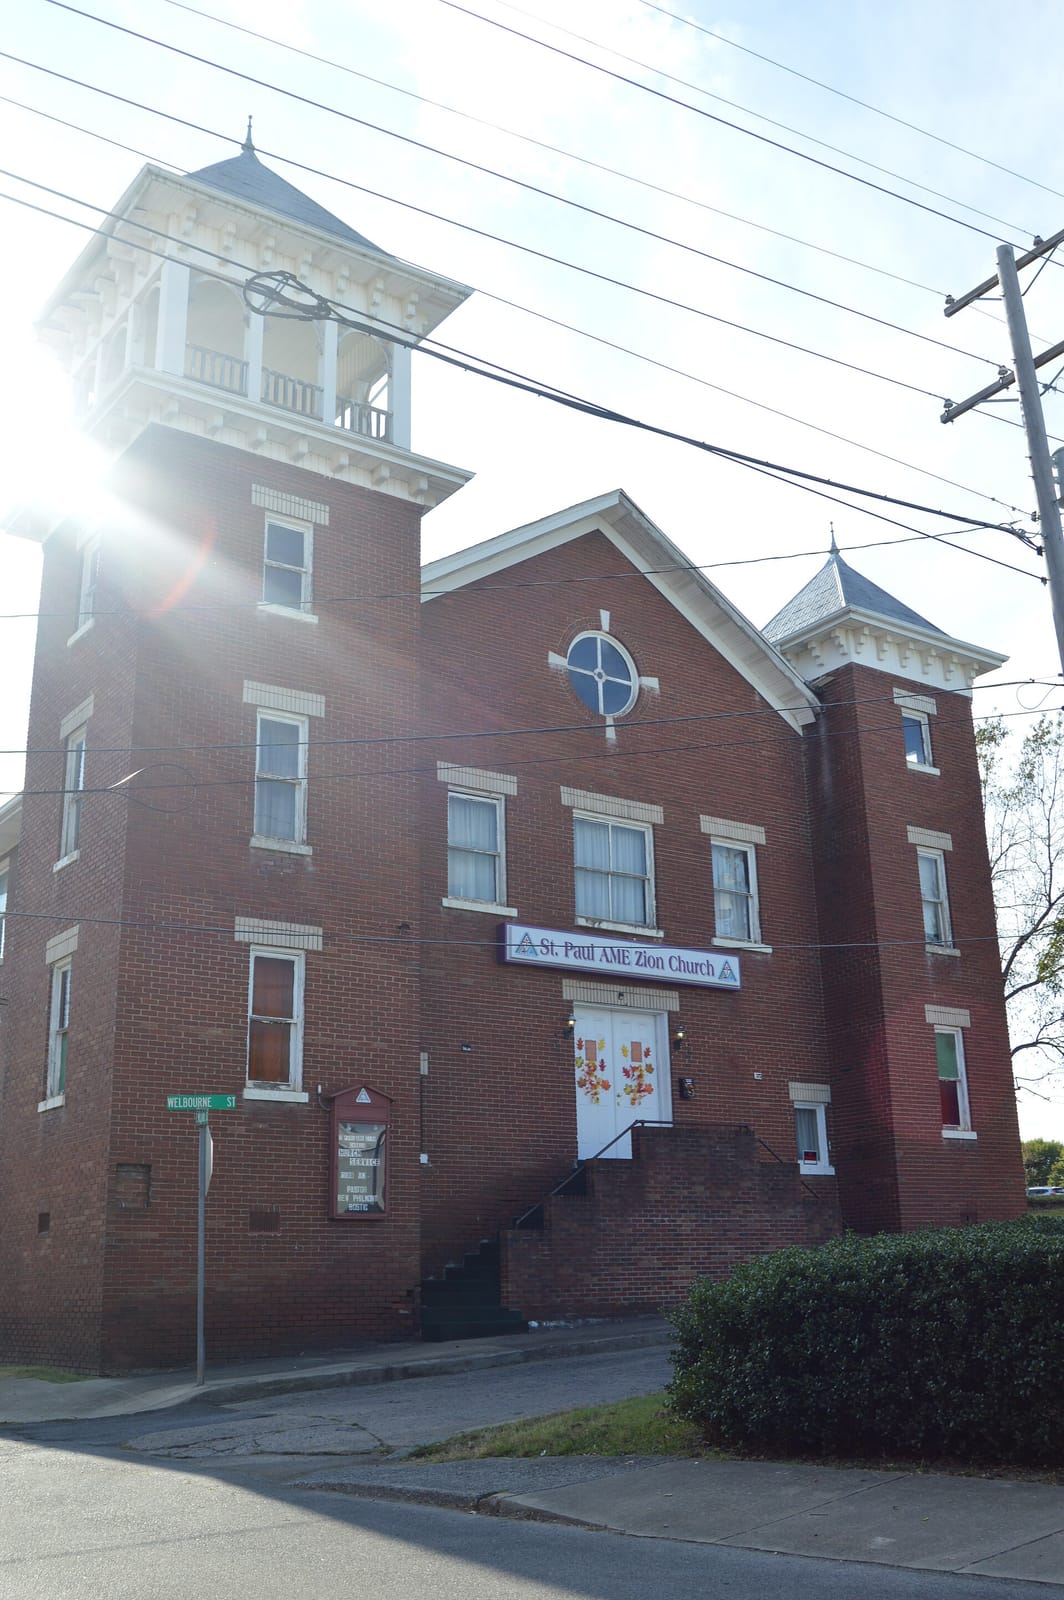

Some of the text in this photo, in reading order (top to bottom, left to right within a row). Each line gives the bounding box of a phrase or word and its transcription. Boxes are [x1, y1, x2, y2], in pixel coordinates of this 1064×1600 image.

[540, 938, 715, 977] St. Paul AME Zion Church
[167, 1096, 236, 1108] WELBOURNE ST
